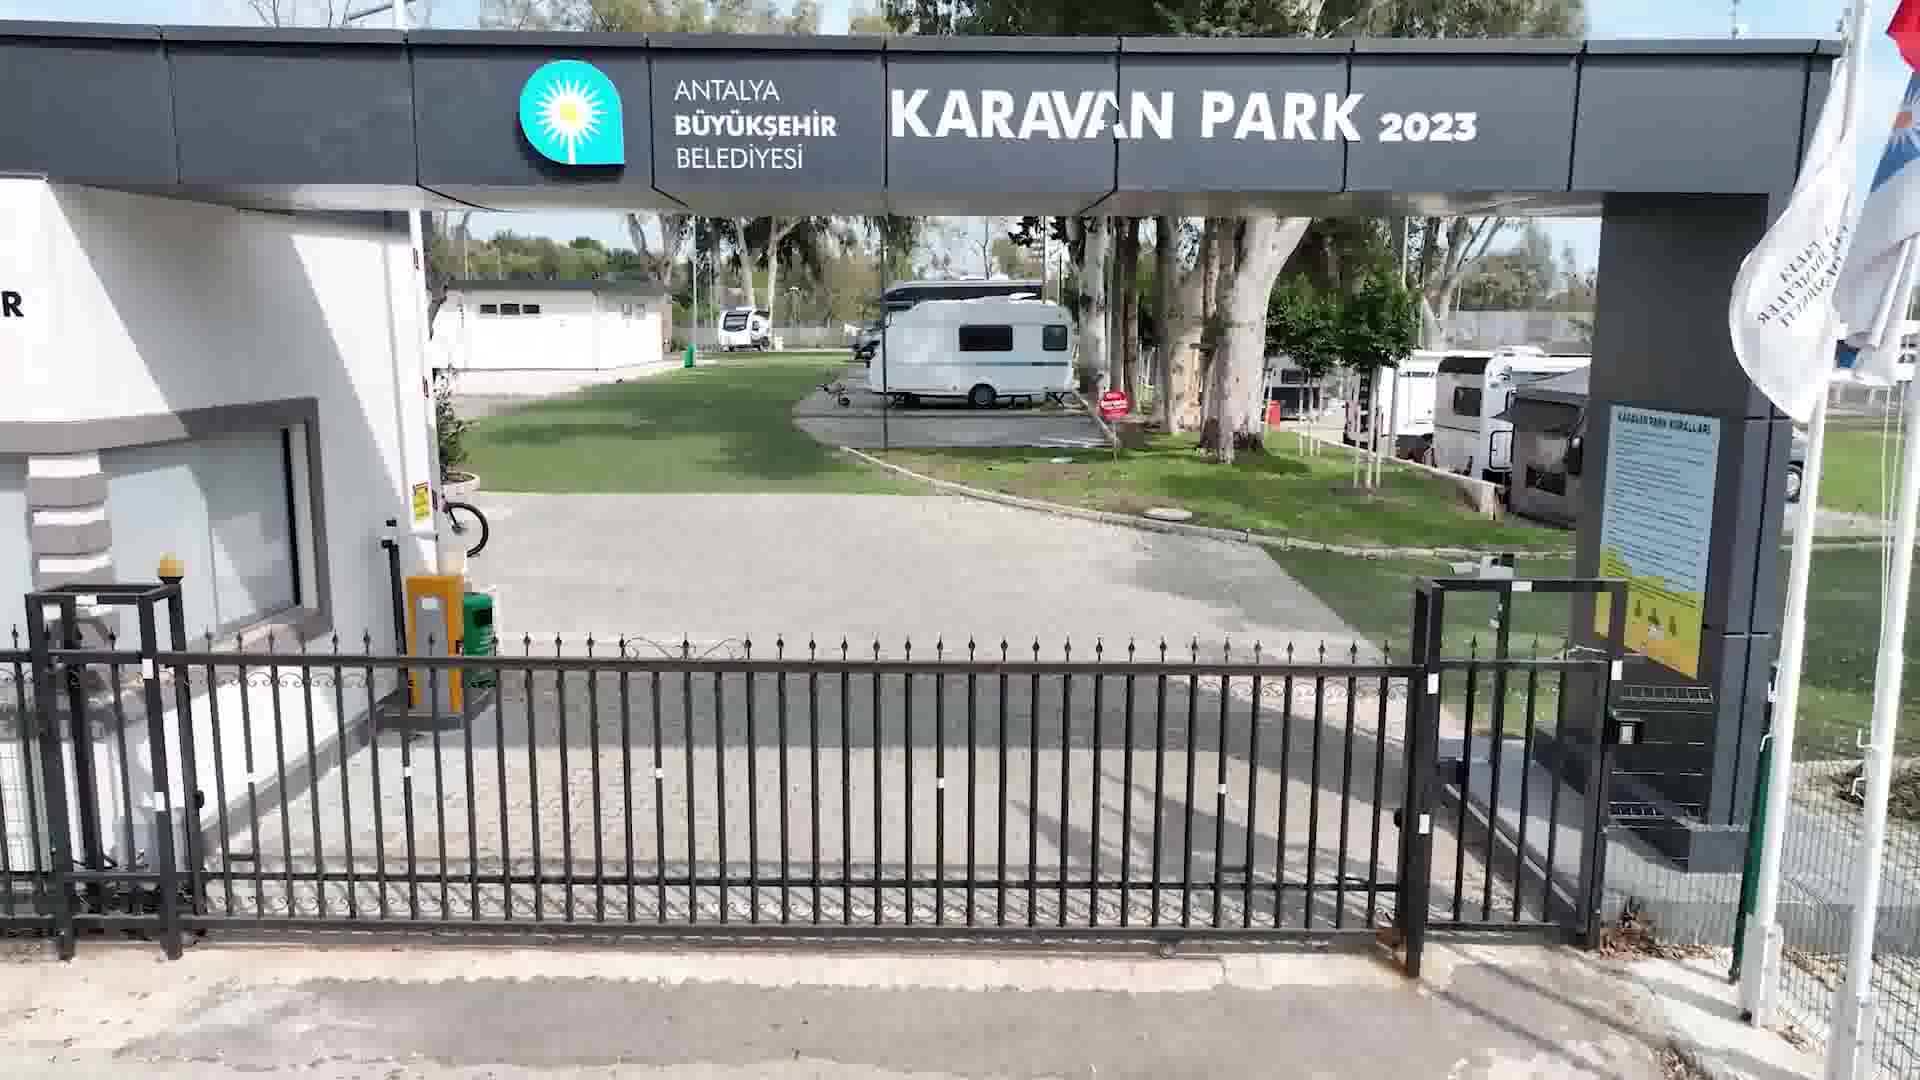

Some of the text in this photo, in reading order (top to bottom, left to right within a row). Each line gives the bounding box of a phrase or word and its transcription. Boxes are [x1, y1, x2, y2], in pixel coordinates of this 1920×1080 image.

[674, 79, 780, 102] ANTALYA
[674, 109, 837, 141] BÜYÜKŞEHİR
[890, 88, 1477, 143] KARAVAN PARK 2023
[677, 143, 803, 169] BELEDİYESİ
